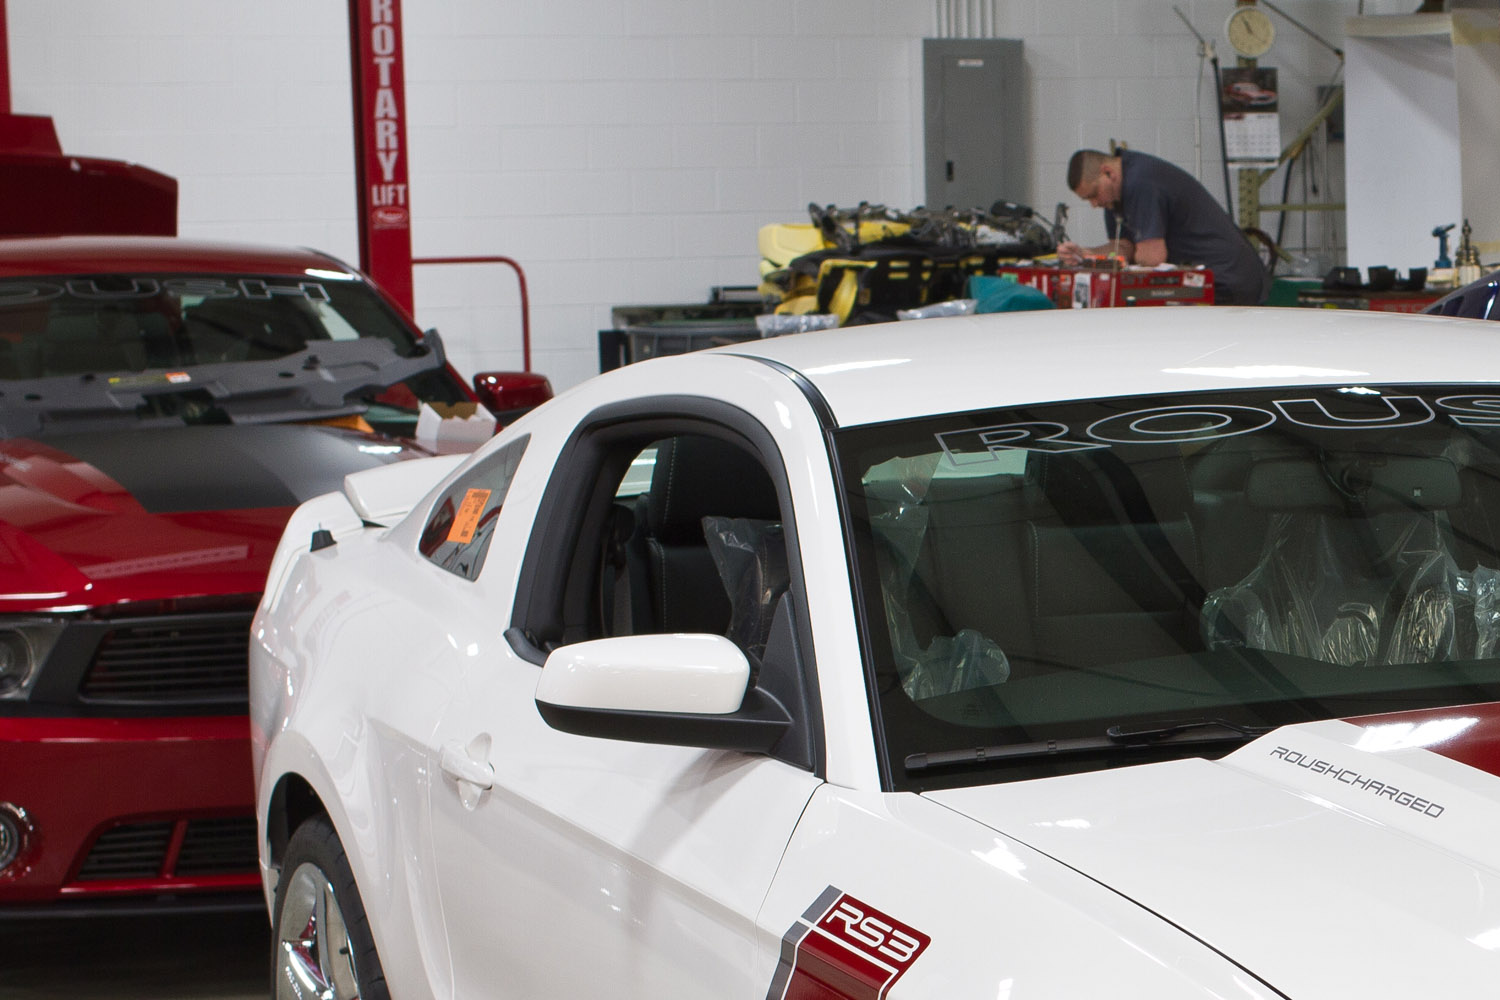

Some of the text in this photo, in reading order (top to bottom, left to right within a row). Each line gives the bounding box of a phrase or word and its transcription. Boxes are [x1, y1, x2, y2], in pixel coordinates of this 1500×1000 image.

[370, 0, 398, 182] ROTARY
[371, 184, 406, 206] LIFT
[1270, 746, 1445, 818] ROUSHCHARGED
[826, 902, 920, 963] RS3
